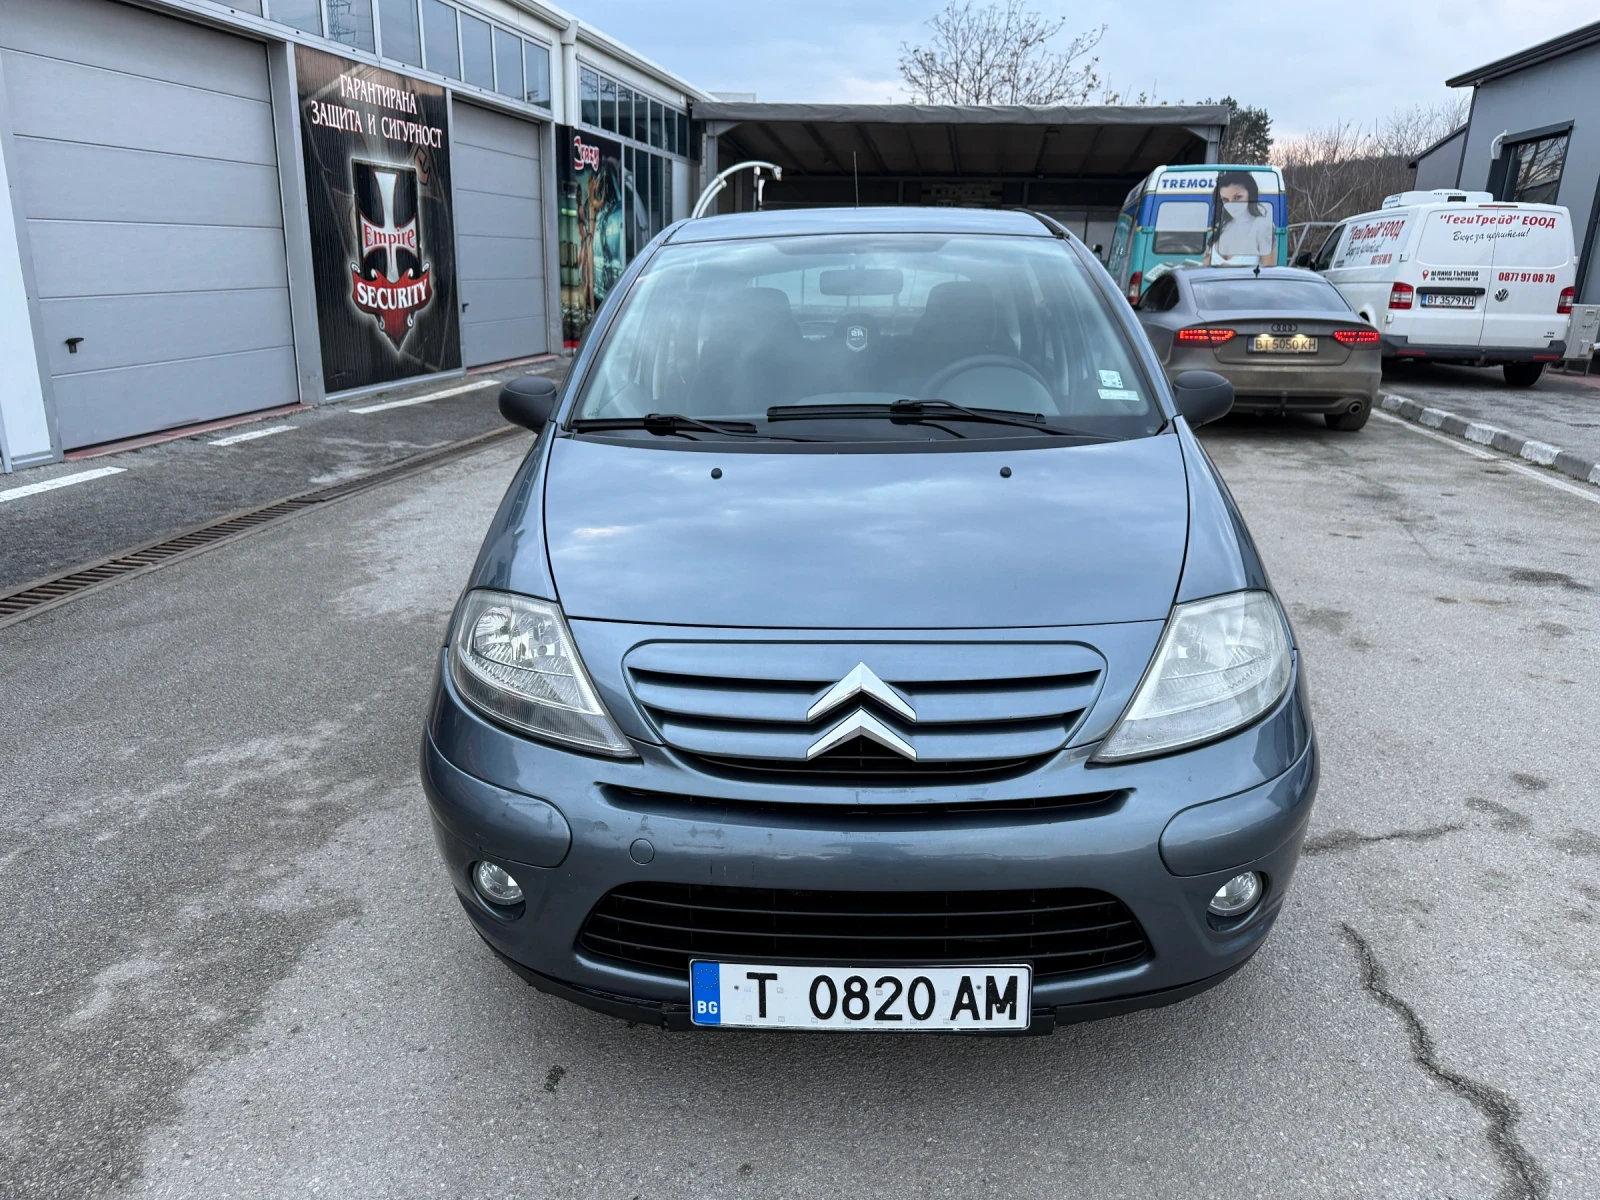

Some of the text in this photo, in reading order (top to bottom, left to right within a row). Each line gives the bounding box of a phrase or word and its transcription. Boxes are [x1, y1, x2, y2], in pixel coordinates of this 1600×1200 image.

[340, 73, 418, 115] ГАРАНТИРАНА
[311, 100, 443, 149] ЗАЩИТА И СИГУРНОСТ
[1162, 178, 1215, 189] TREMOL
[1521, 215, 1556, 229] ЕООД
[363, 222, 416, 258] Empire
[1453, 230, 1474, 243] Вкус
[1498, 272, 1556, 283] 0877 97 08 78
[356, 278, 428, 311] SECURITY
[1427, 295, 1475, 306] BT 3579 KH
[1255, 339, 1316, 350] BT 5050 KH
[746, 971, 1018, 1021] T 0820 AM
[697, 1000, 718, 1015] BG
